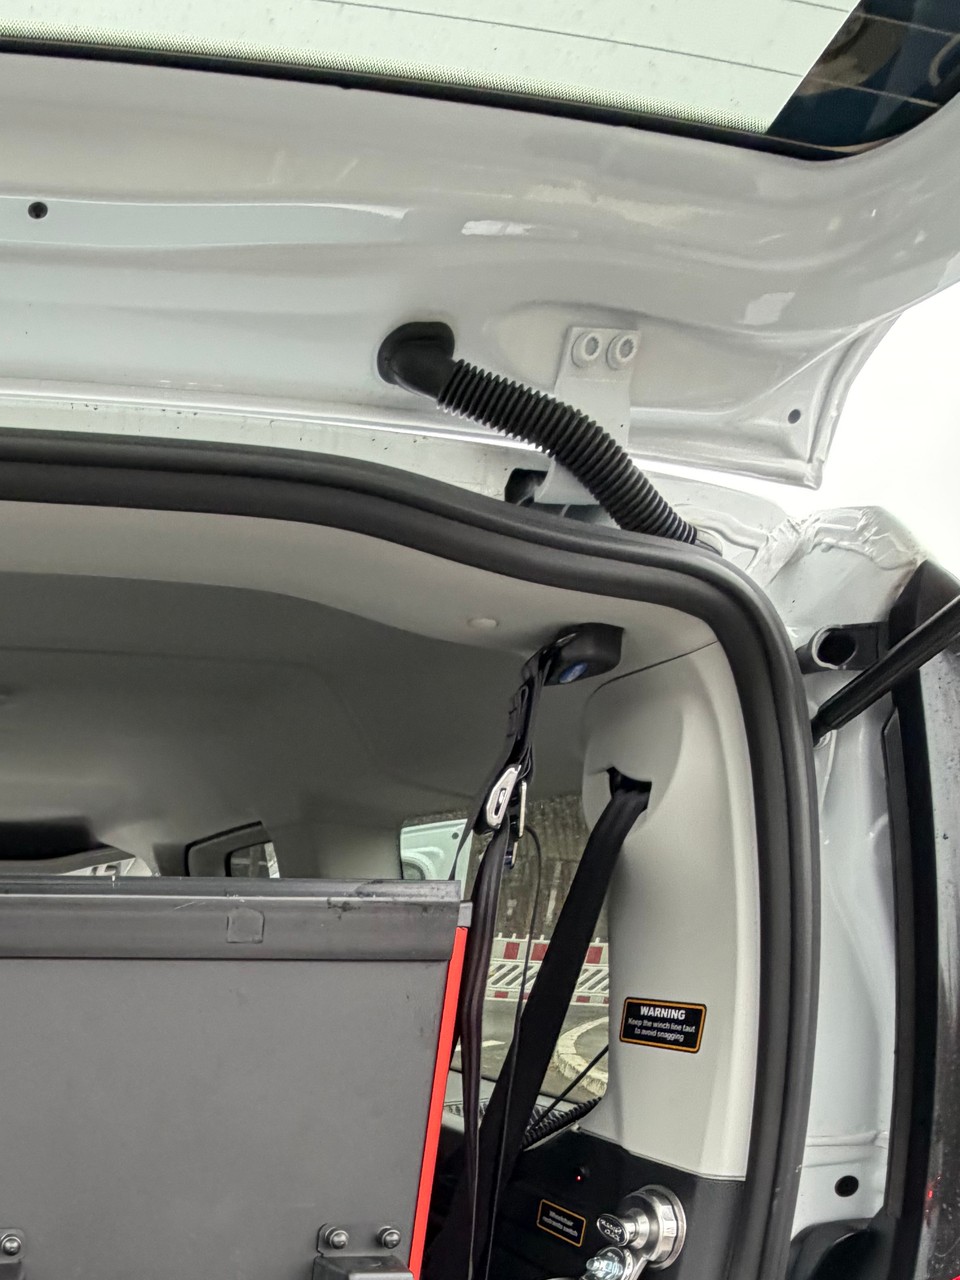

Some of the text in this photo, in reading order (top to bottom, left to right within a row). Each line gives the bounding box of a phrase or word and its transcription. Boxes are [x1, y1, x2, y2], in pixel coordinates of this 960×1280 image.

[640, 1005, 686, 1020] WARNING
[627, 1017, 643, 1027] Keep
[642, 1019, 653, 1027] the
[652, 1021, 671, 1030] winch
[682, 1024, 696, 1033] taut
[641, 1028, 657, 1037] avoid
[657, 1031, 685, 1042] snagging
